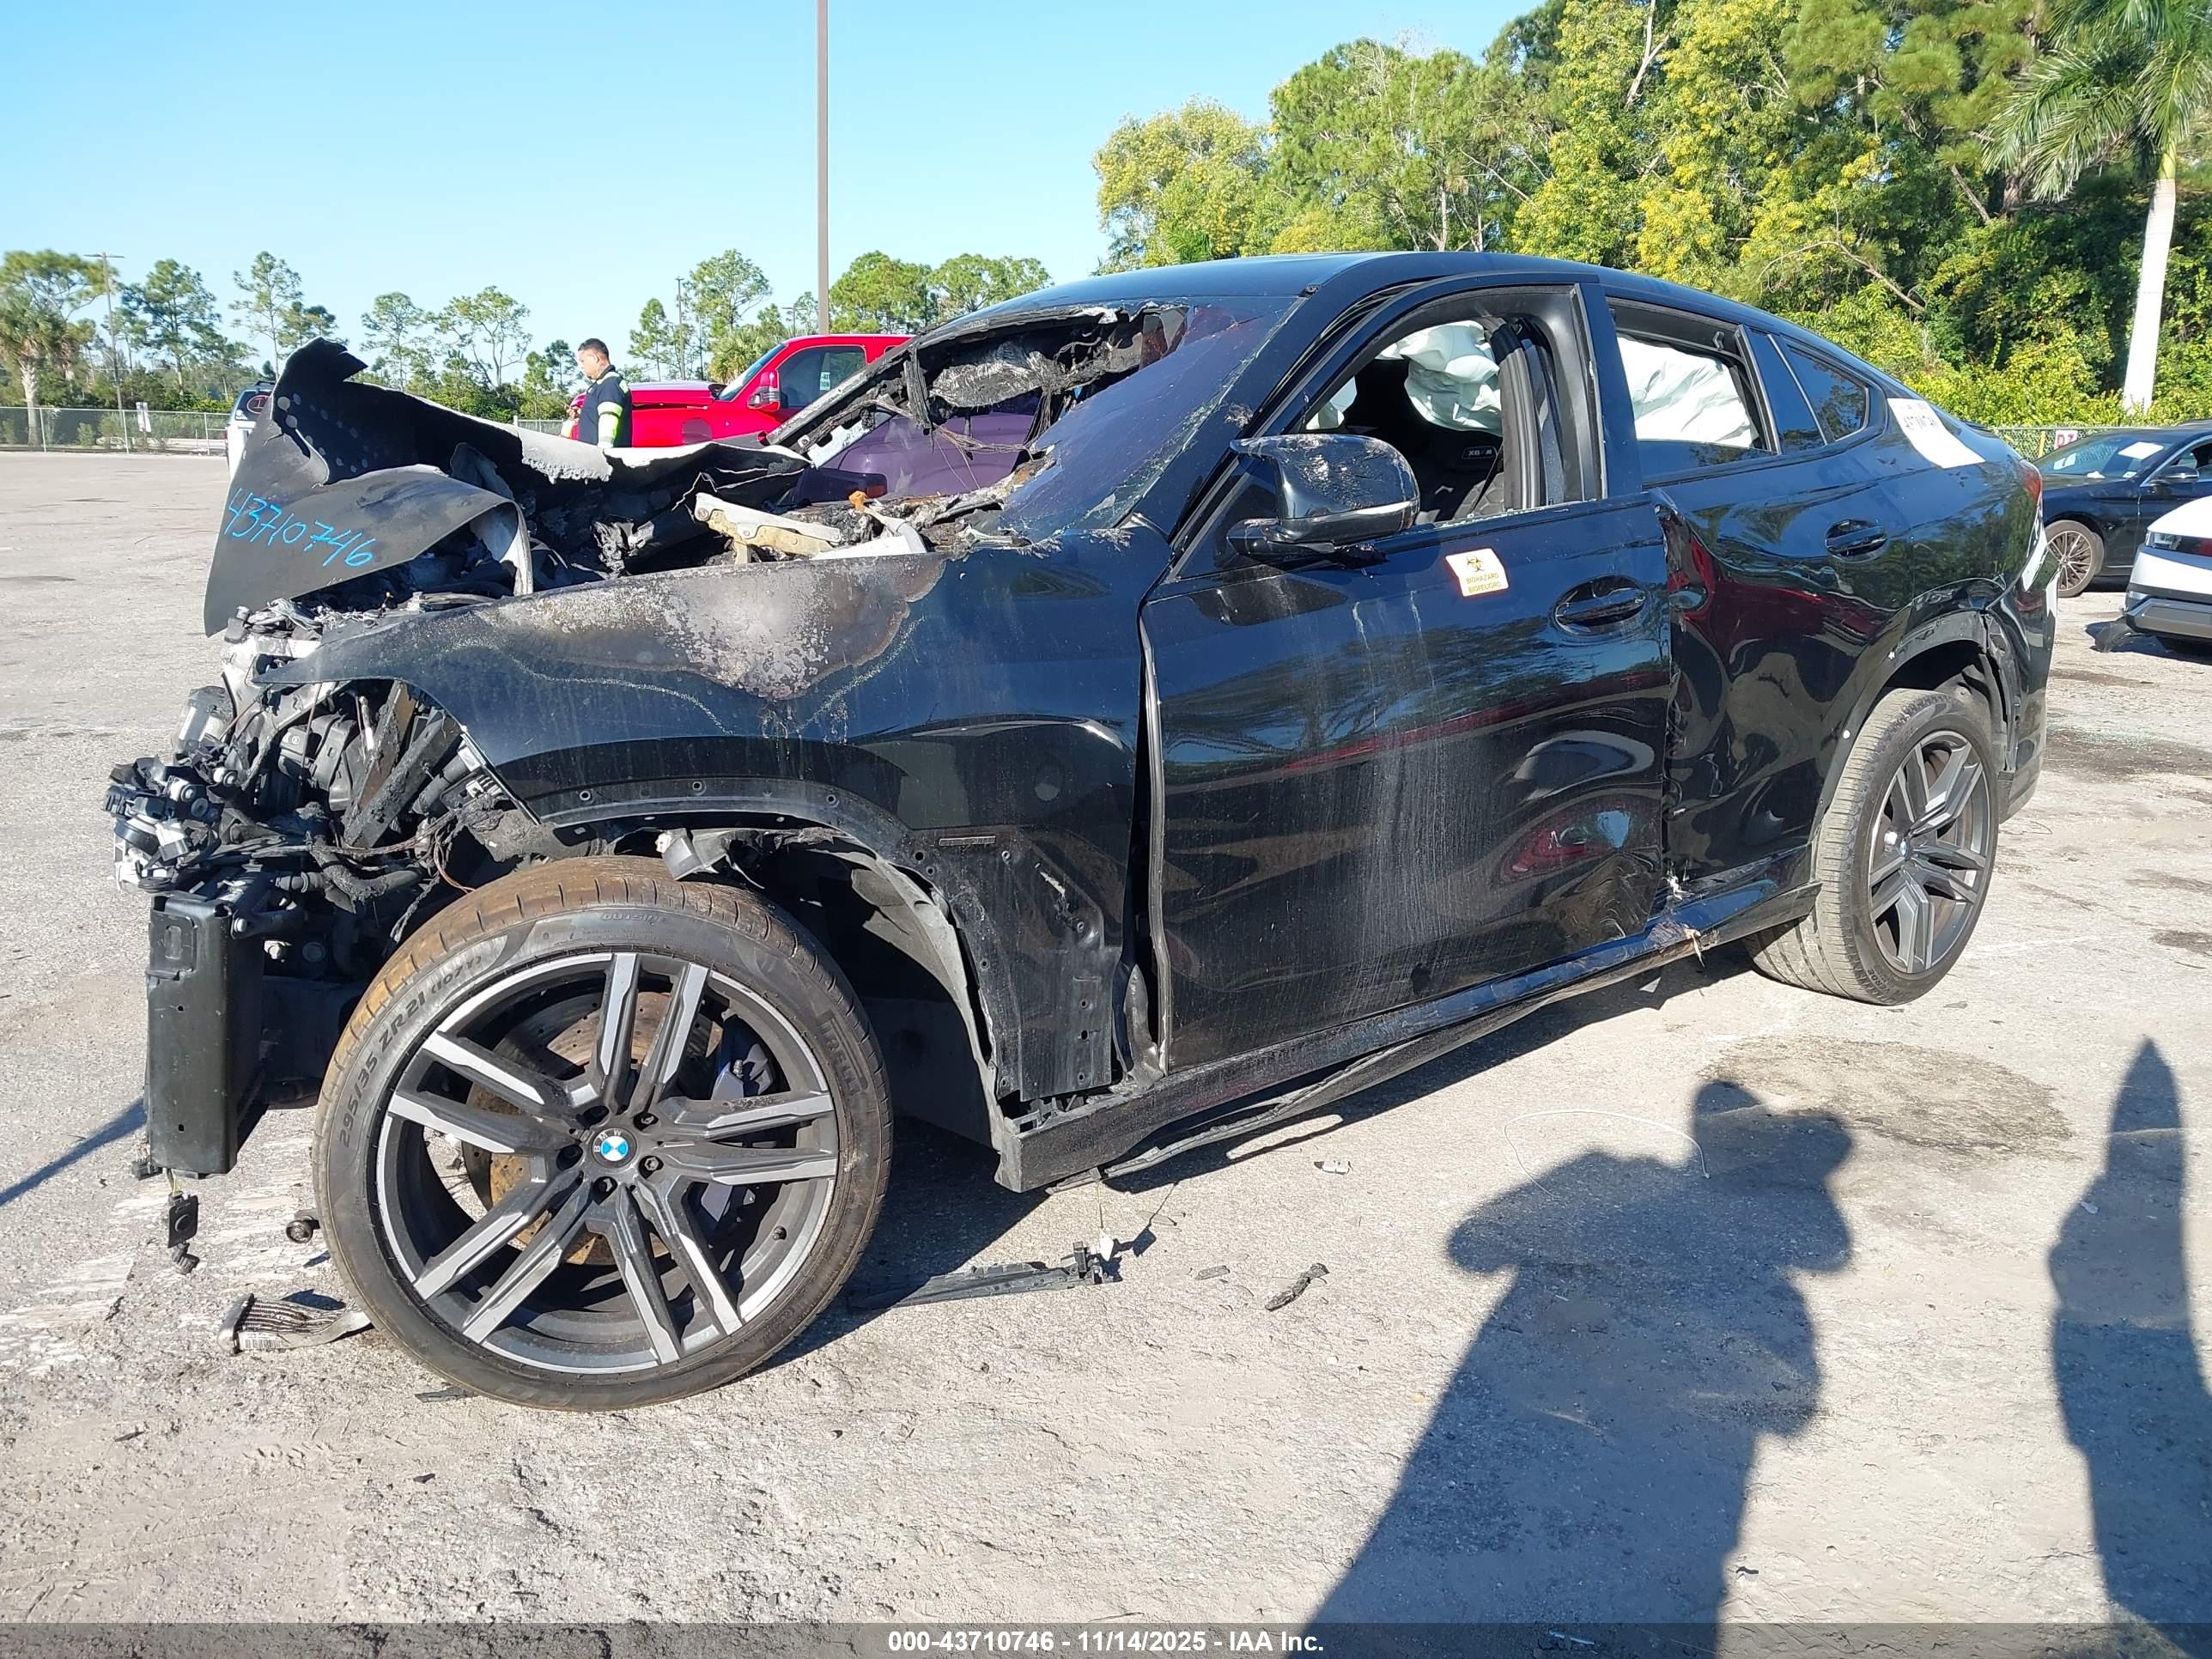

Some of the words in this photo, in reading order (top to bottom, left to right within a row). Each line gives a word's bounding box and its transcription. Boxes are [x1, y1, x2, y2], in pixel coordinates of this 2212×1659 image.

[223, 487, 376, 568] 43710746
[1466, 571, 1499, 585] BIOHAZARD
[340, 1052, 378, 1148] 295/35
[593, 1128, 622, 1152] BMW
